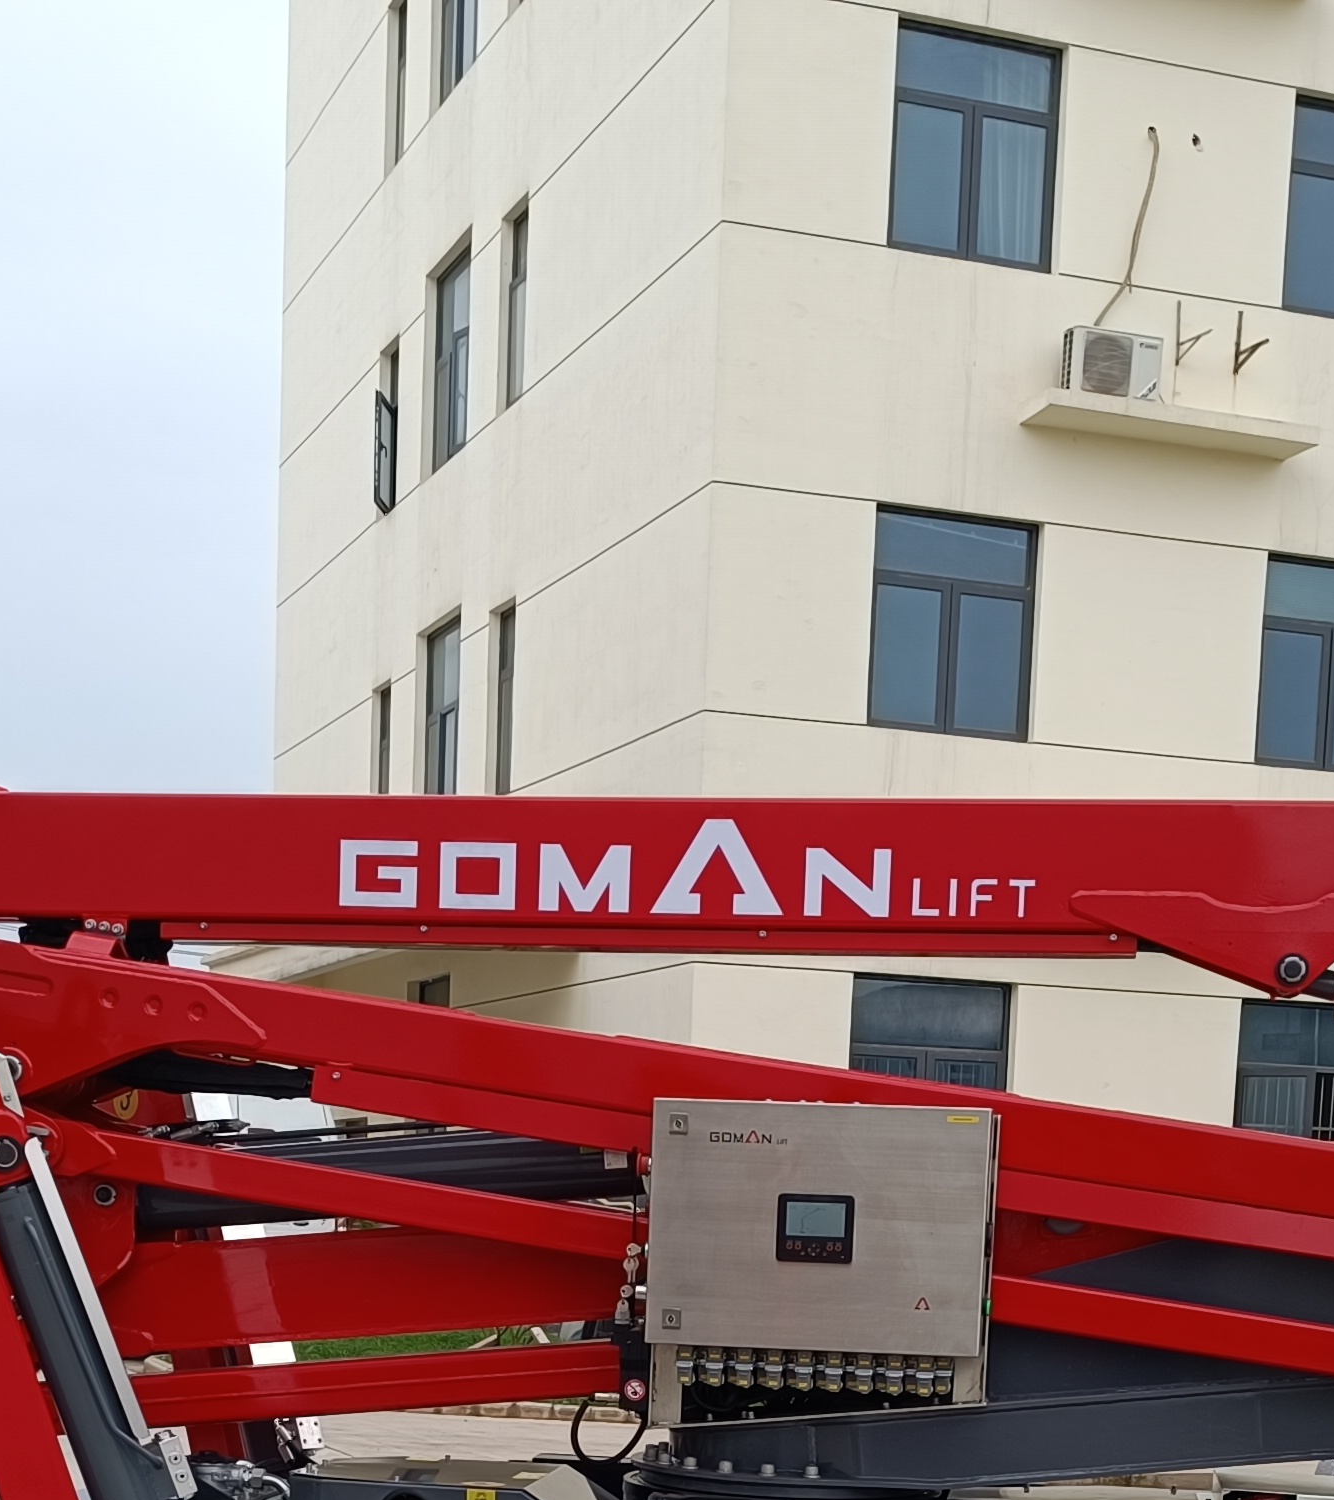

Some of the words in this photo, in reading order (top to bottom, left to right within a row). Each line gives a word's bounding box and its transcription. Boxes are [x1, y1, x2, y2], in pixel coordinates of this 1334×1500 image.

[338, 818, 893, 918] GOMAN
[911, 877, 1037, 918] LIFT
[709, 1129, 773, 1145] GOMAN
